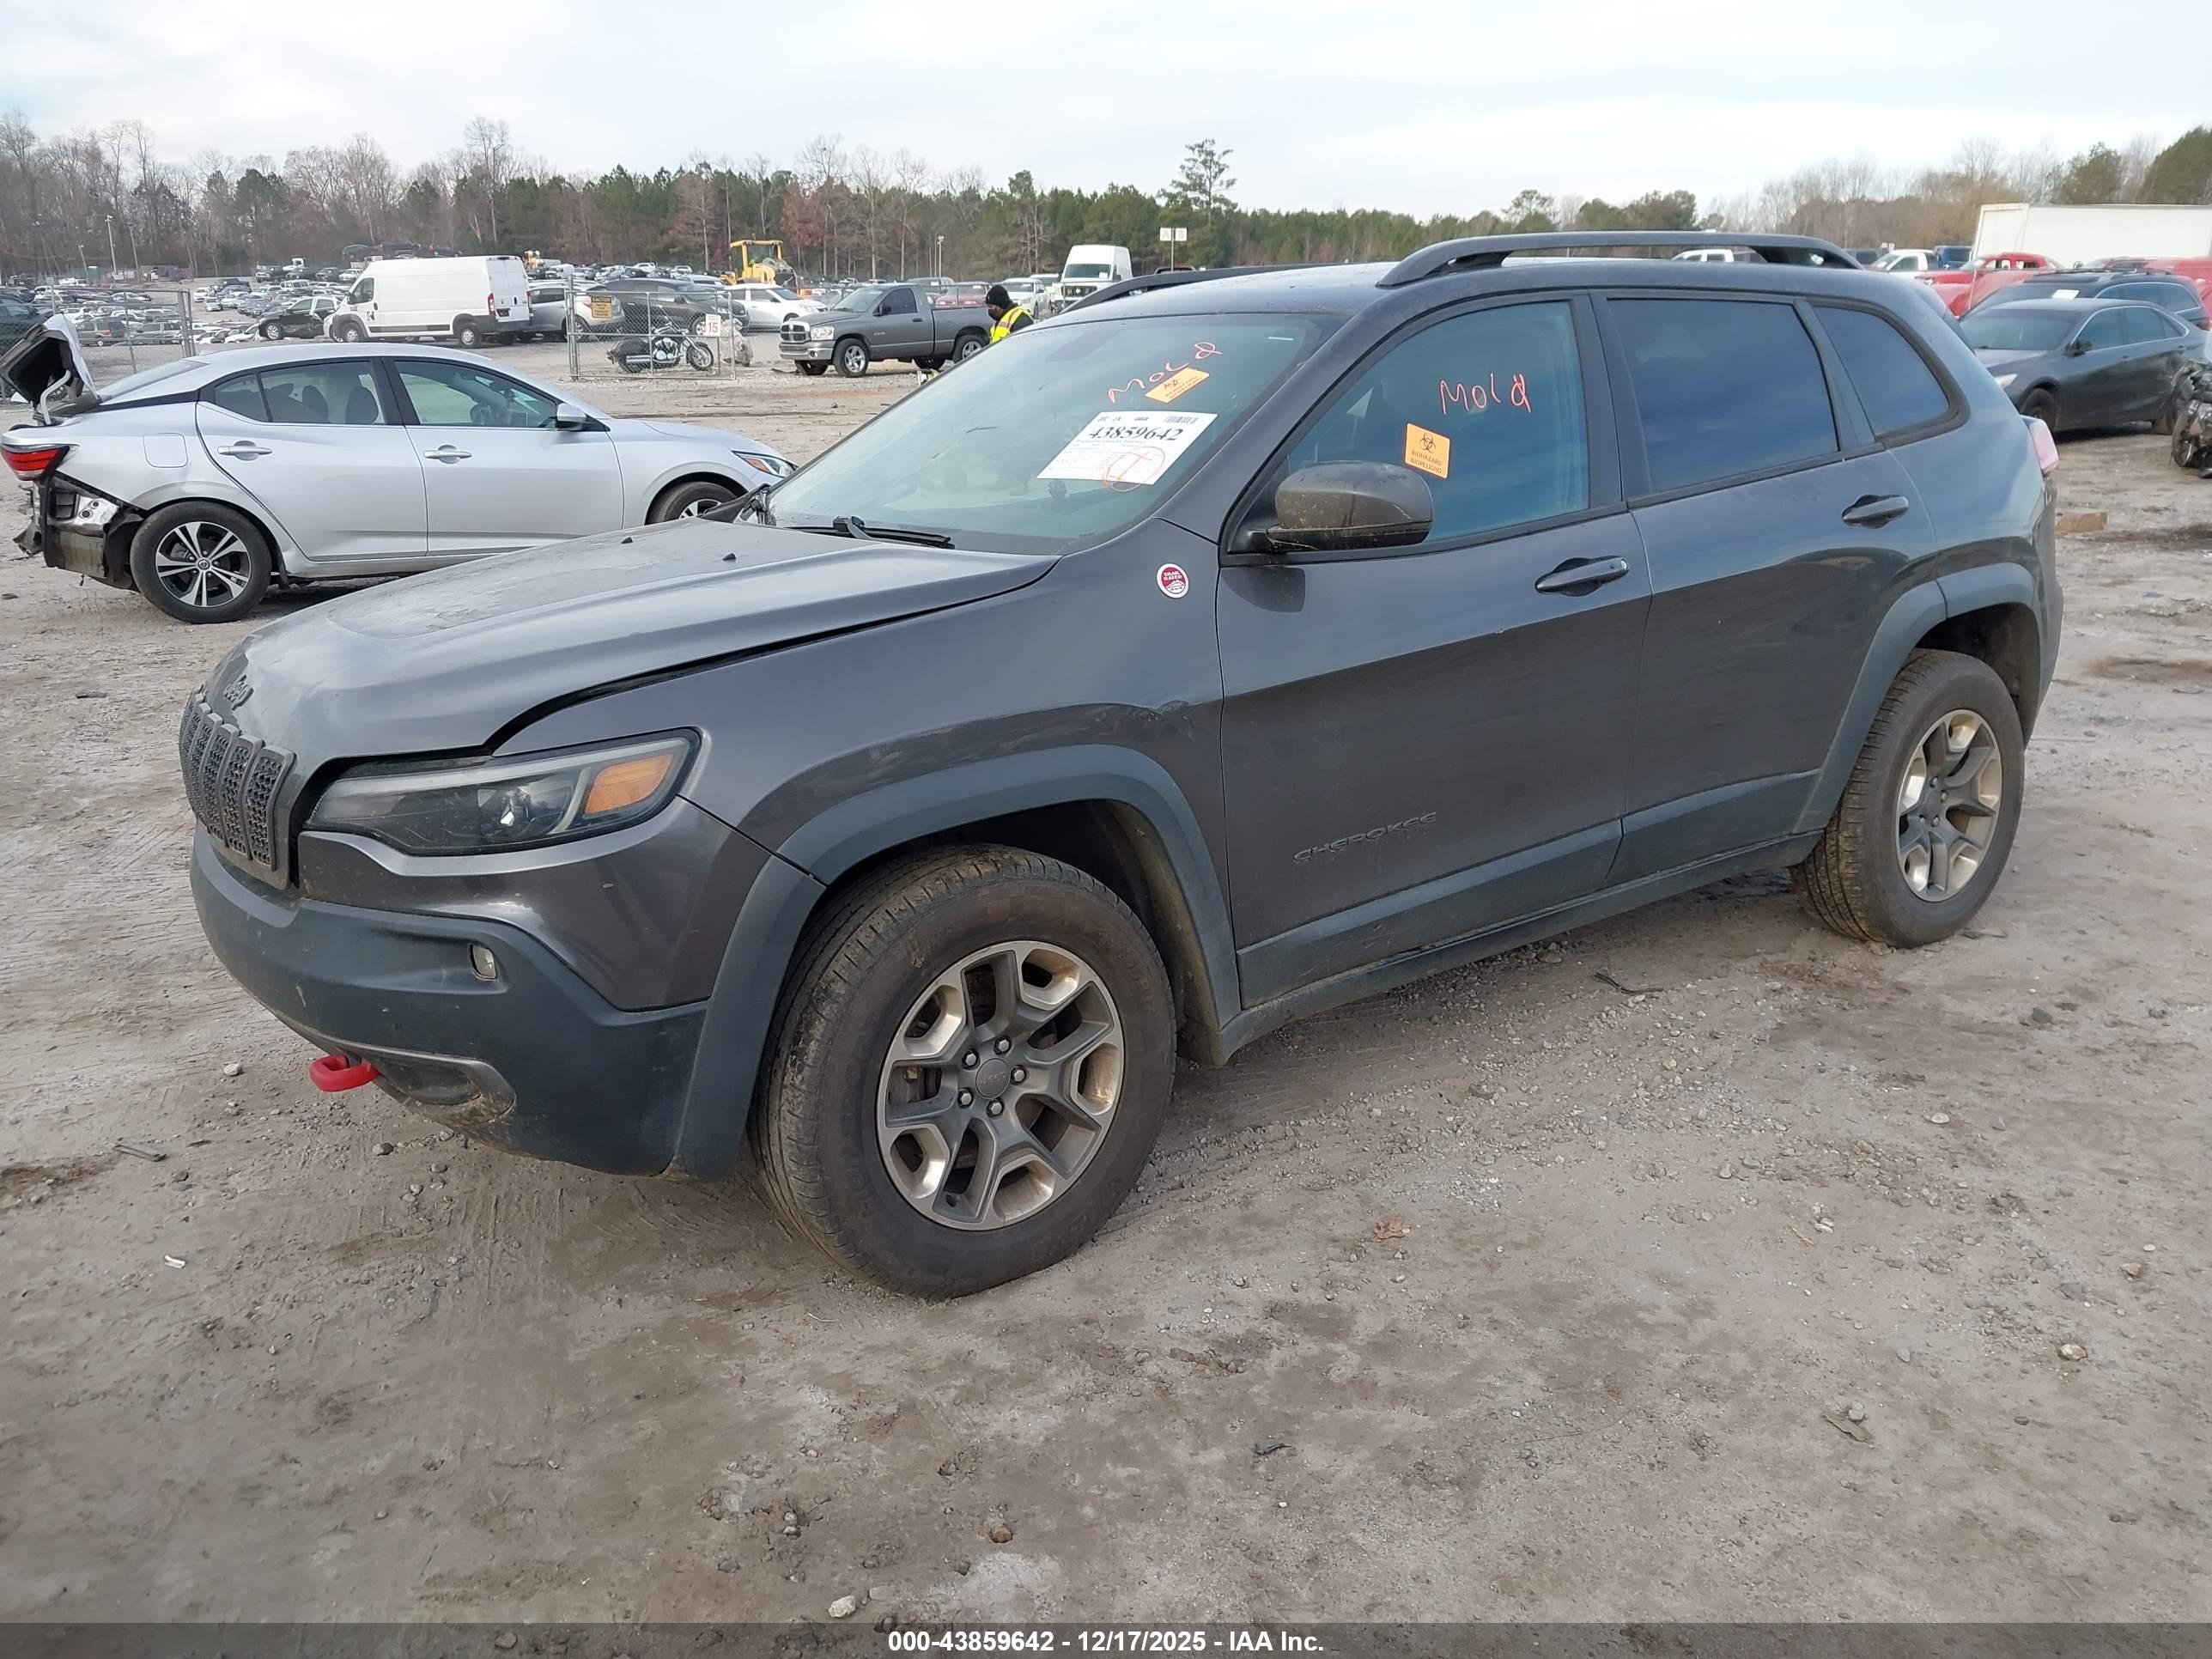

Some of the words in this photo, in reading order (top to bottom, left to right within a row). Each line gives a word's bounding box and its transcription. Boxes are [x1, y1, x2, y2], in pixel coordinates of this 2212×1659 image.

[708, 321, 719, 333] 15
[1439, 372, 1532, 415] Mold
[1089, 426, 1184, 441] 43859642
[1411, 449, 1443, 466] BIOHAZARD
[1293, 811, 1437, 862] CHEROKEE
